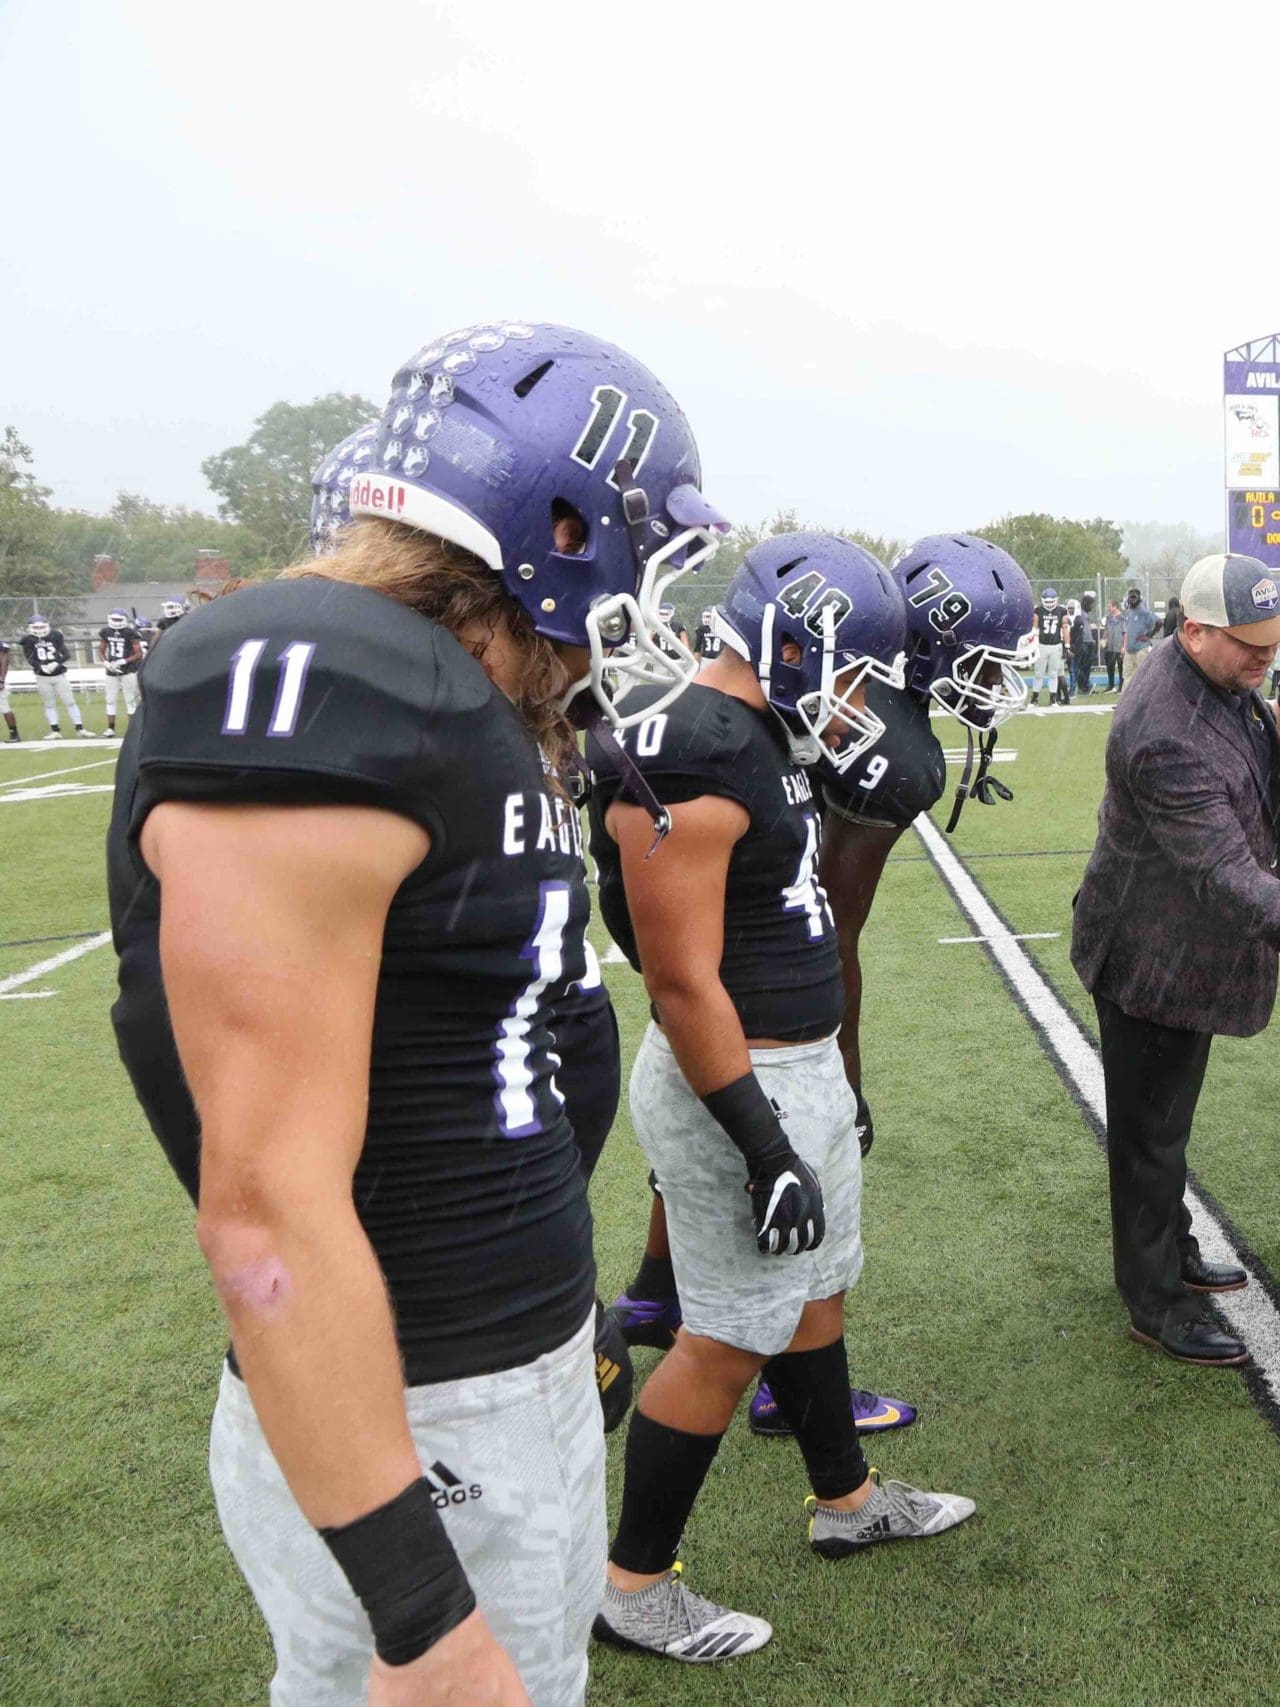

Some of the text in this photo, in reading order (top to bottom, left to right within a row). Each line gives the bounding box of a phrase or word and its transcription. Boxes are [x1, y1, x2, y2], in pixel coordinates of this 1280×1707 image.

[571, 384, 660, 492] 11
[352, 480, 405, 514] ddell
[1245, 491, 1275, 503] AVILA
[1251, 505, 1265, 528] 0
[776, 570, 853, 639] 40
[908, 567, 972, 633] 79
[221, 638, 316, 737] 11
[781, 811, 836, 944] 4
[495, 879, 573, 1141] 1
[434, 1483, 483, 1510] das
